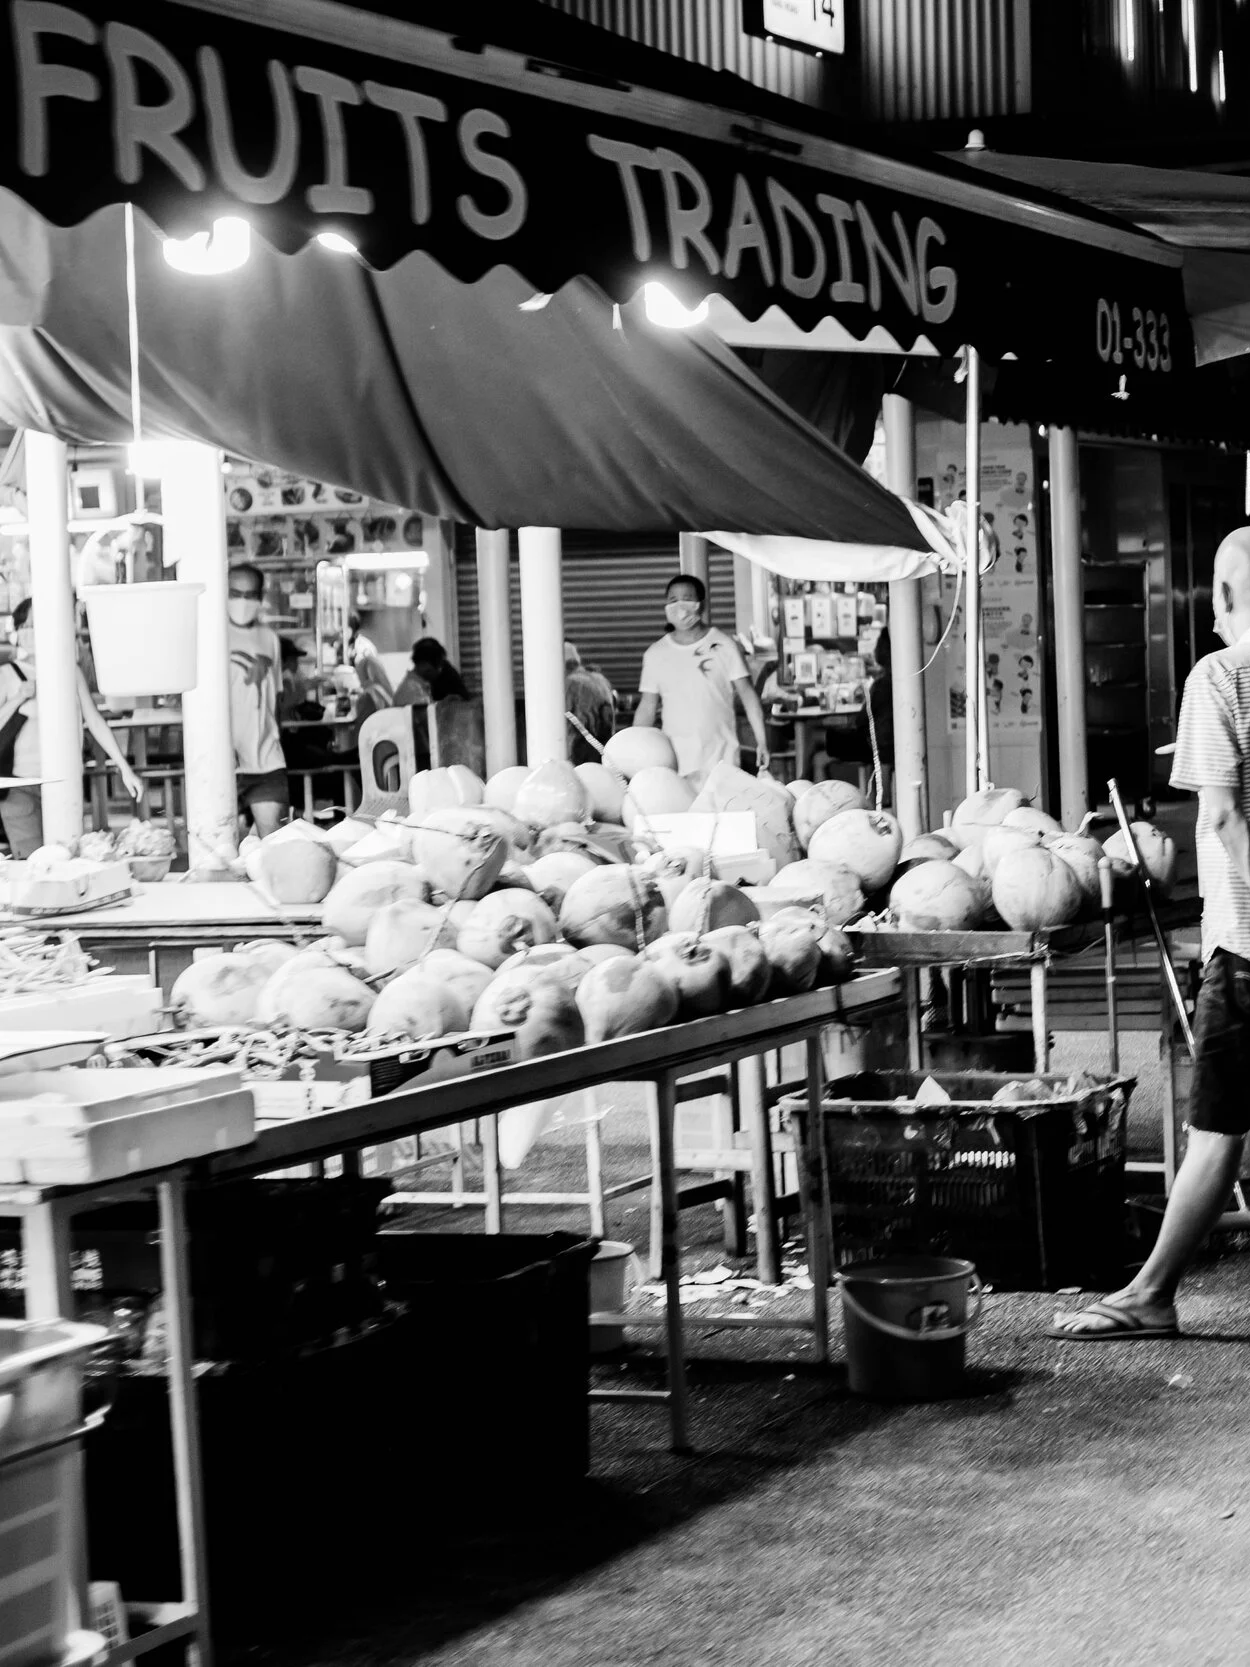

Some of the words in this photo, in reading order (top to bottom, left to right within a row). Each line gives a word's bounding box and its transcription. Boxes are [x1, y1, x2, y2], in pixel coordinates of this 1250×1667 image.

[10, 0, 528, 240] FRUITS
[587, 133, 958, 324] TRADING
[1096, 298, 1172, 373] 01-333
